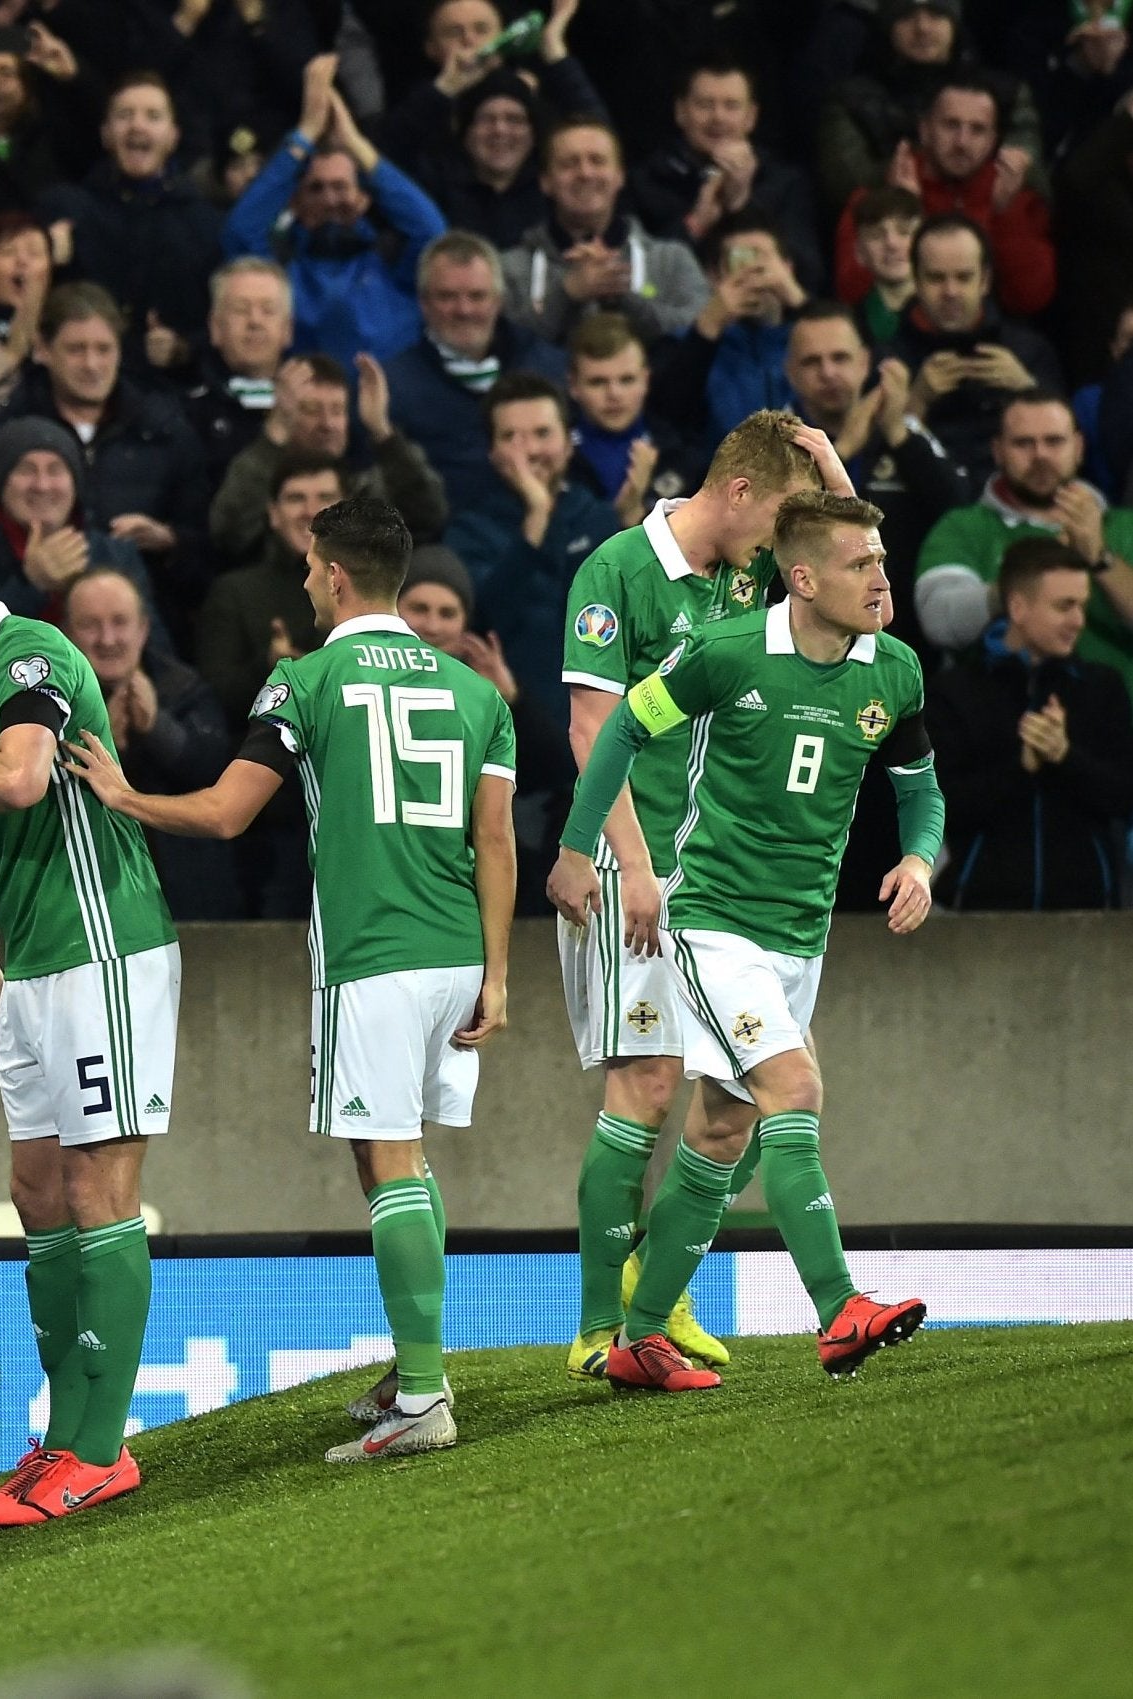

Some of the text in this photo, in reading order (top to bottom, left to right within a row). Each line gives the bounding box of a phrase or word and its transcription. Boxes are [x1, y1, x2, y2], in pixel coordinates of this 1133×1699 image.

[352, 645, 438, 672] JONES
[735, 701, 768, 712] adidas
[341, 683, 464, 828] 15
[786, 734, 825, 794] 8
[76, 1054, 112, 1116] 5
[144, 1106, 170, 1115] adidas
[339, 1109, 371, 1118] adidas
